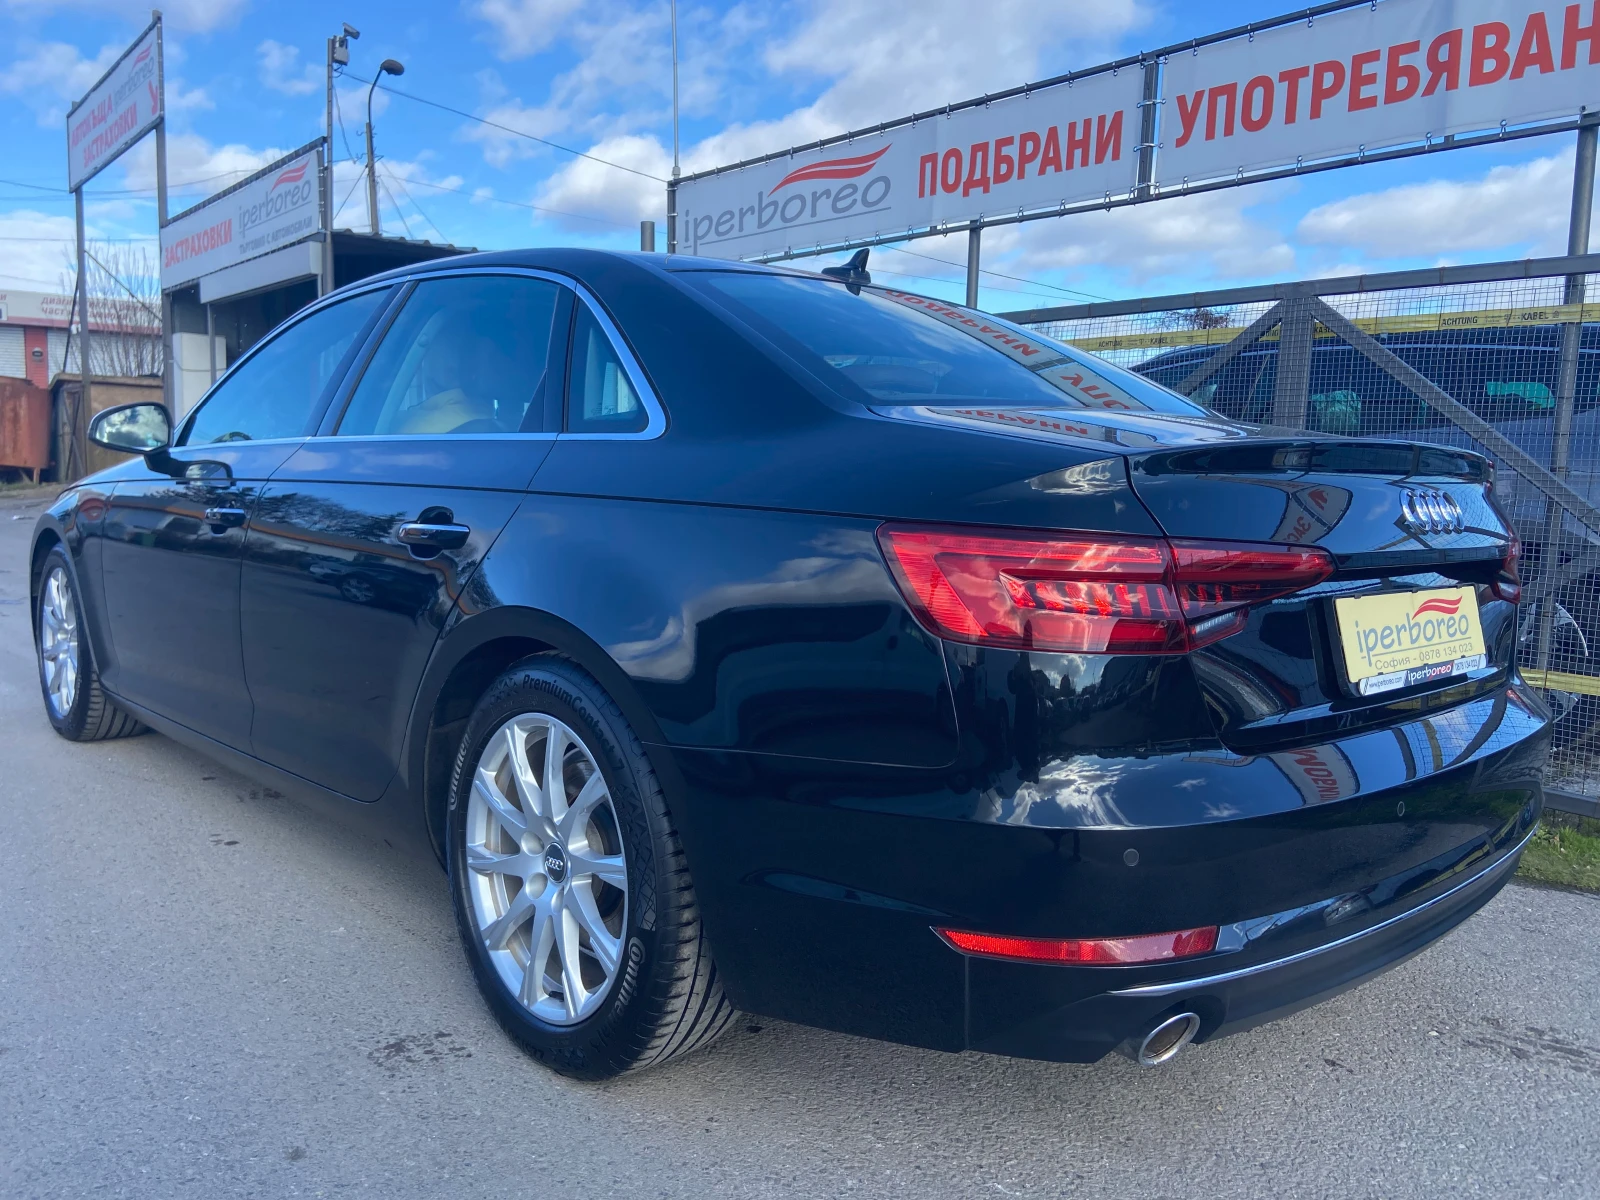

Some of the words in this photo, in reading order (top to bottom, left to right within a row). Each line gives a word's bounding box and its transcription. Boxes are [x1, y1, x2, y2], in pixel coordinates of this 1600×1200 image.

[1174, 2, 1600, 149] УПОТРЕБЯВАН
[83, 102, 138, 169] ЗАСТРАХОВКИ
[918, 110, 1124, 199] ПОДБРАНИ
[238, 179, 312, 239] iperboreo
[684, 174, 892, 256] iperboreo
[164, 218, 233, 269] ЗАСТРАХОВКИ
[1441, 315, 1478, 327] ACHTUNG
[1521, 311, 1549, 321] KABEL
[1355, 612, 1470, 668] iperboreo
[1374, 656, 1411, 671] София
[1419, 648, 1441, 662] 0878
[1443, 645, 1458, 657] 134
[1458, 642, 1473, 653] 023
[1407, 664, 1452, 685] iperboreo
[521, 673, 617, 754] PremiumContact
